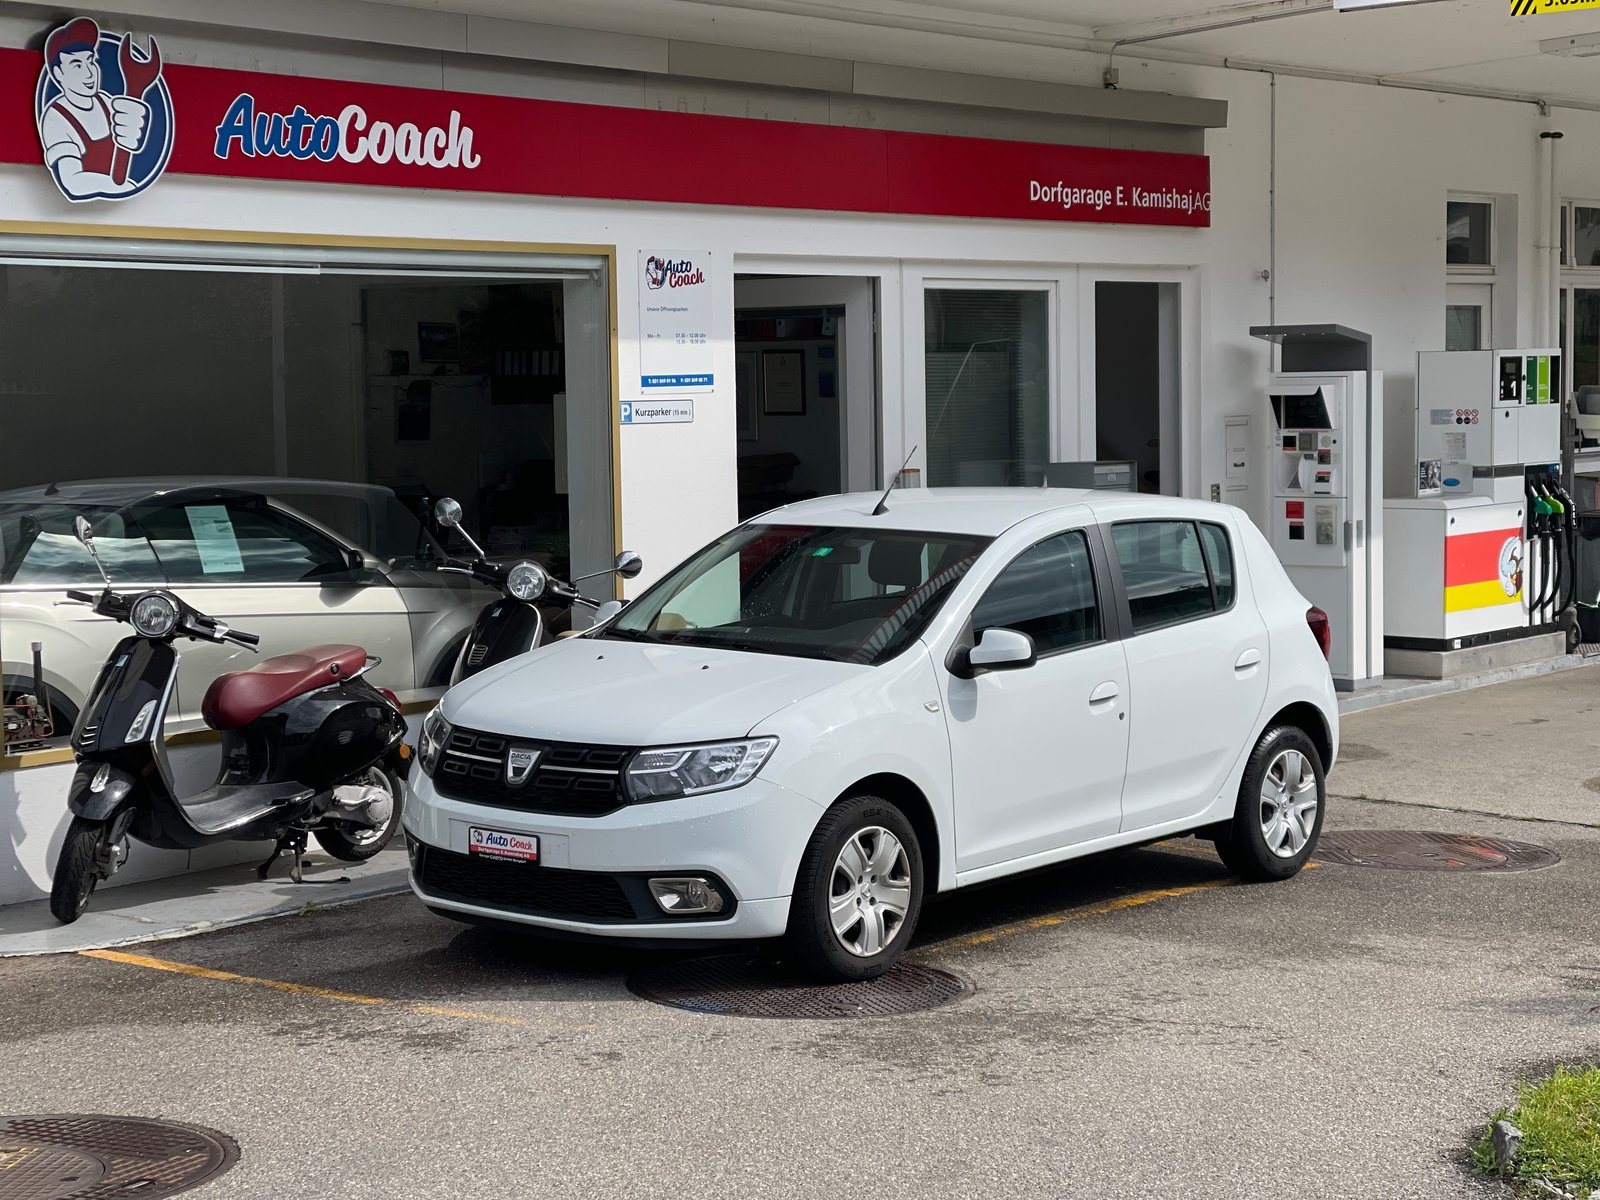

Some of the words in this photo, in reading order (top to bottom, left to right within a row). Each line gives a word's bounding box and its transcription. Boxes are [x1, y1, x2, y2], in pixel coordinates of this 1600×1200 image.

[1030, 180, 1113, 210] Dorfgarage
[1116, 186, 1128, 206] E.
[1132, 186, 1193, 215] Kamishaj
[665, 259, 692, 277] Auto
[669, 268, 706, 288] Coach
[1510, 380, 1517, 397] 1
[635, 408, 671, 418] Kurzparker
[511, 752, 531, 760] DACIA
[486, 832, 508, 847] Auto
[509, 836, 533, 851] Coach
